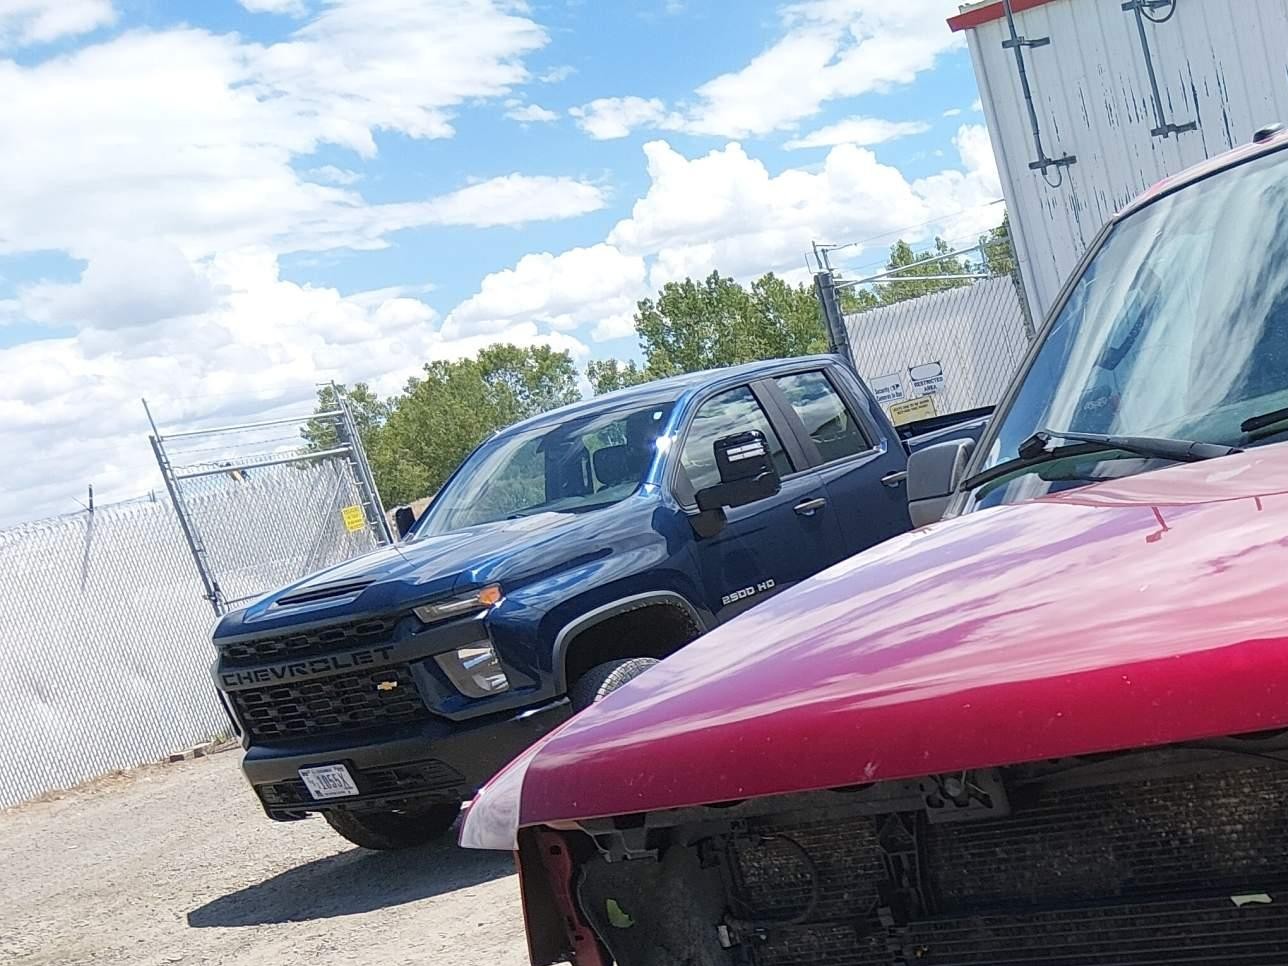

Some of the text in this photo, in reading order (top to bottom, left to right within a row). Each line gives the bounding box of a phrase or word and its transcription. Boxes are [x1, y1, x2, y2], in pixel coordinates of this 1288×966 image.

[722, 579, 776, 605] 2500 HD
[222, 645, 394, 686] CHEVROLET
